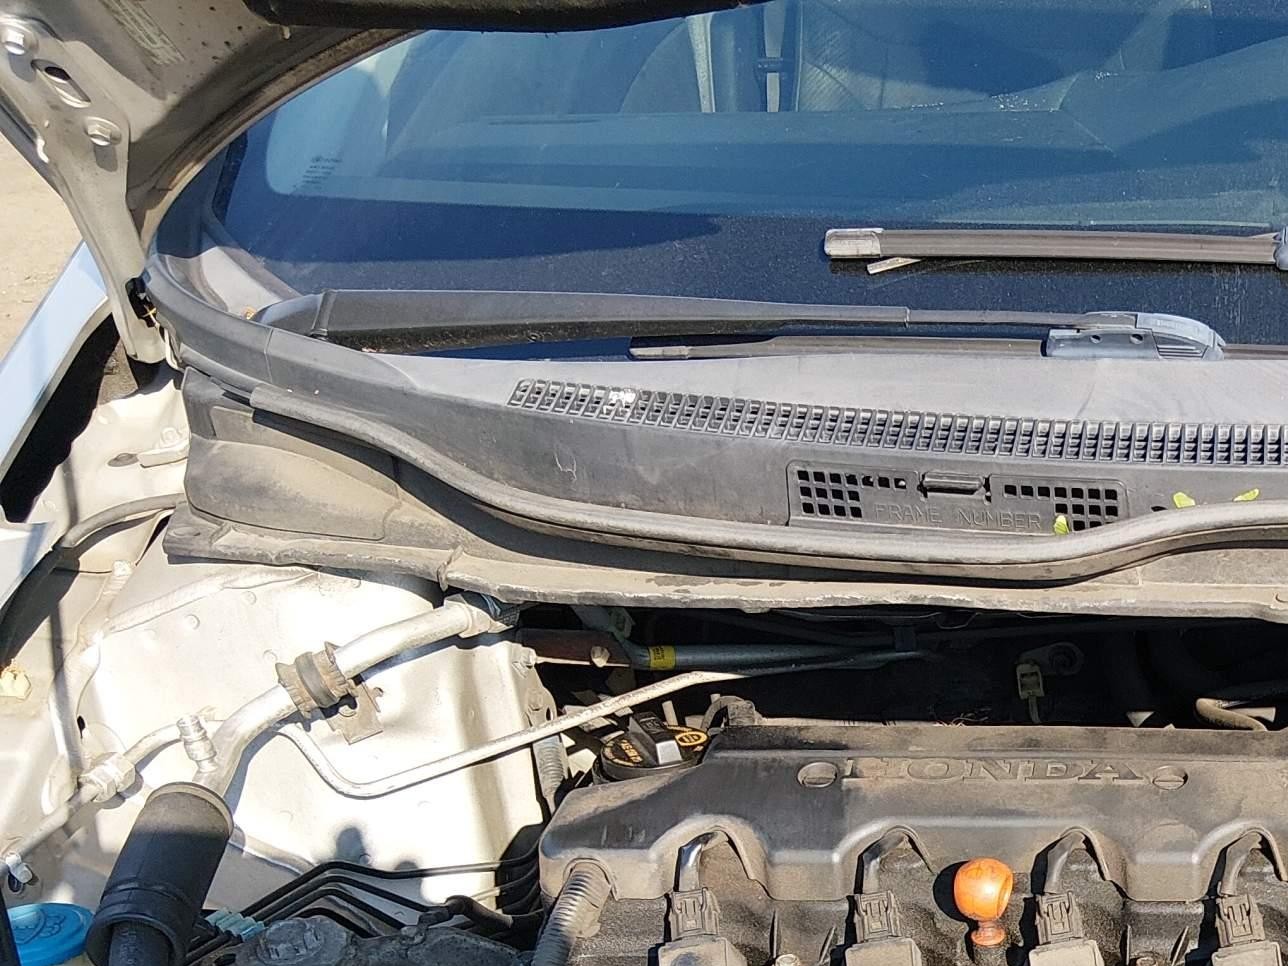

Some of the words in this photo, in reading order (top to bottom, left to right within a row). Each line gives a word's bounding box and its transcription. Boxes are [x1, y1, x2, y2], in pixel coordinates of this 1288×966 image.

[873, 503, 943, 525] FRAME
[958, 510, 1044, 530] NUMBER
[842, 758, 1145, 784] HONDA
